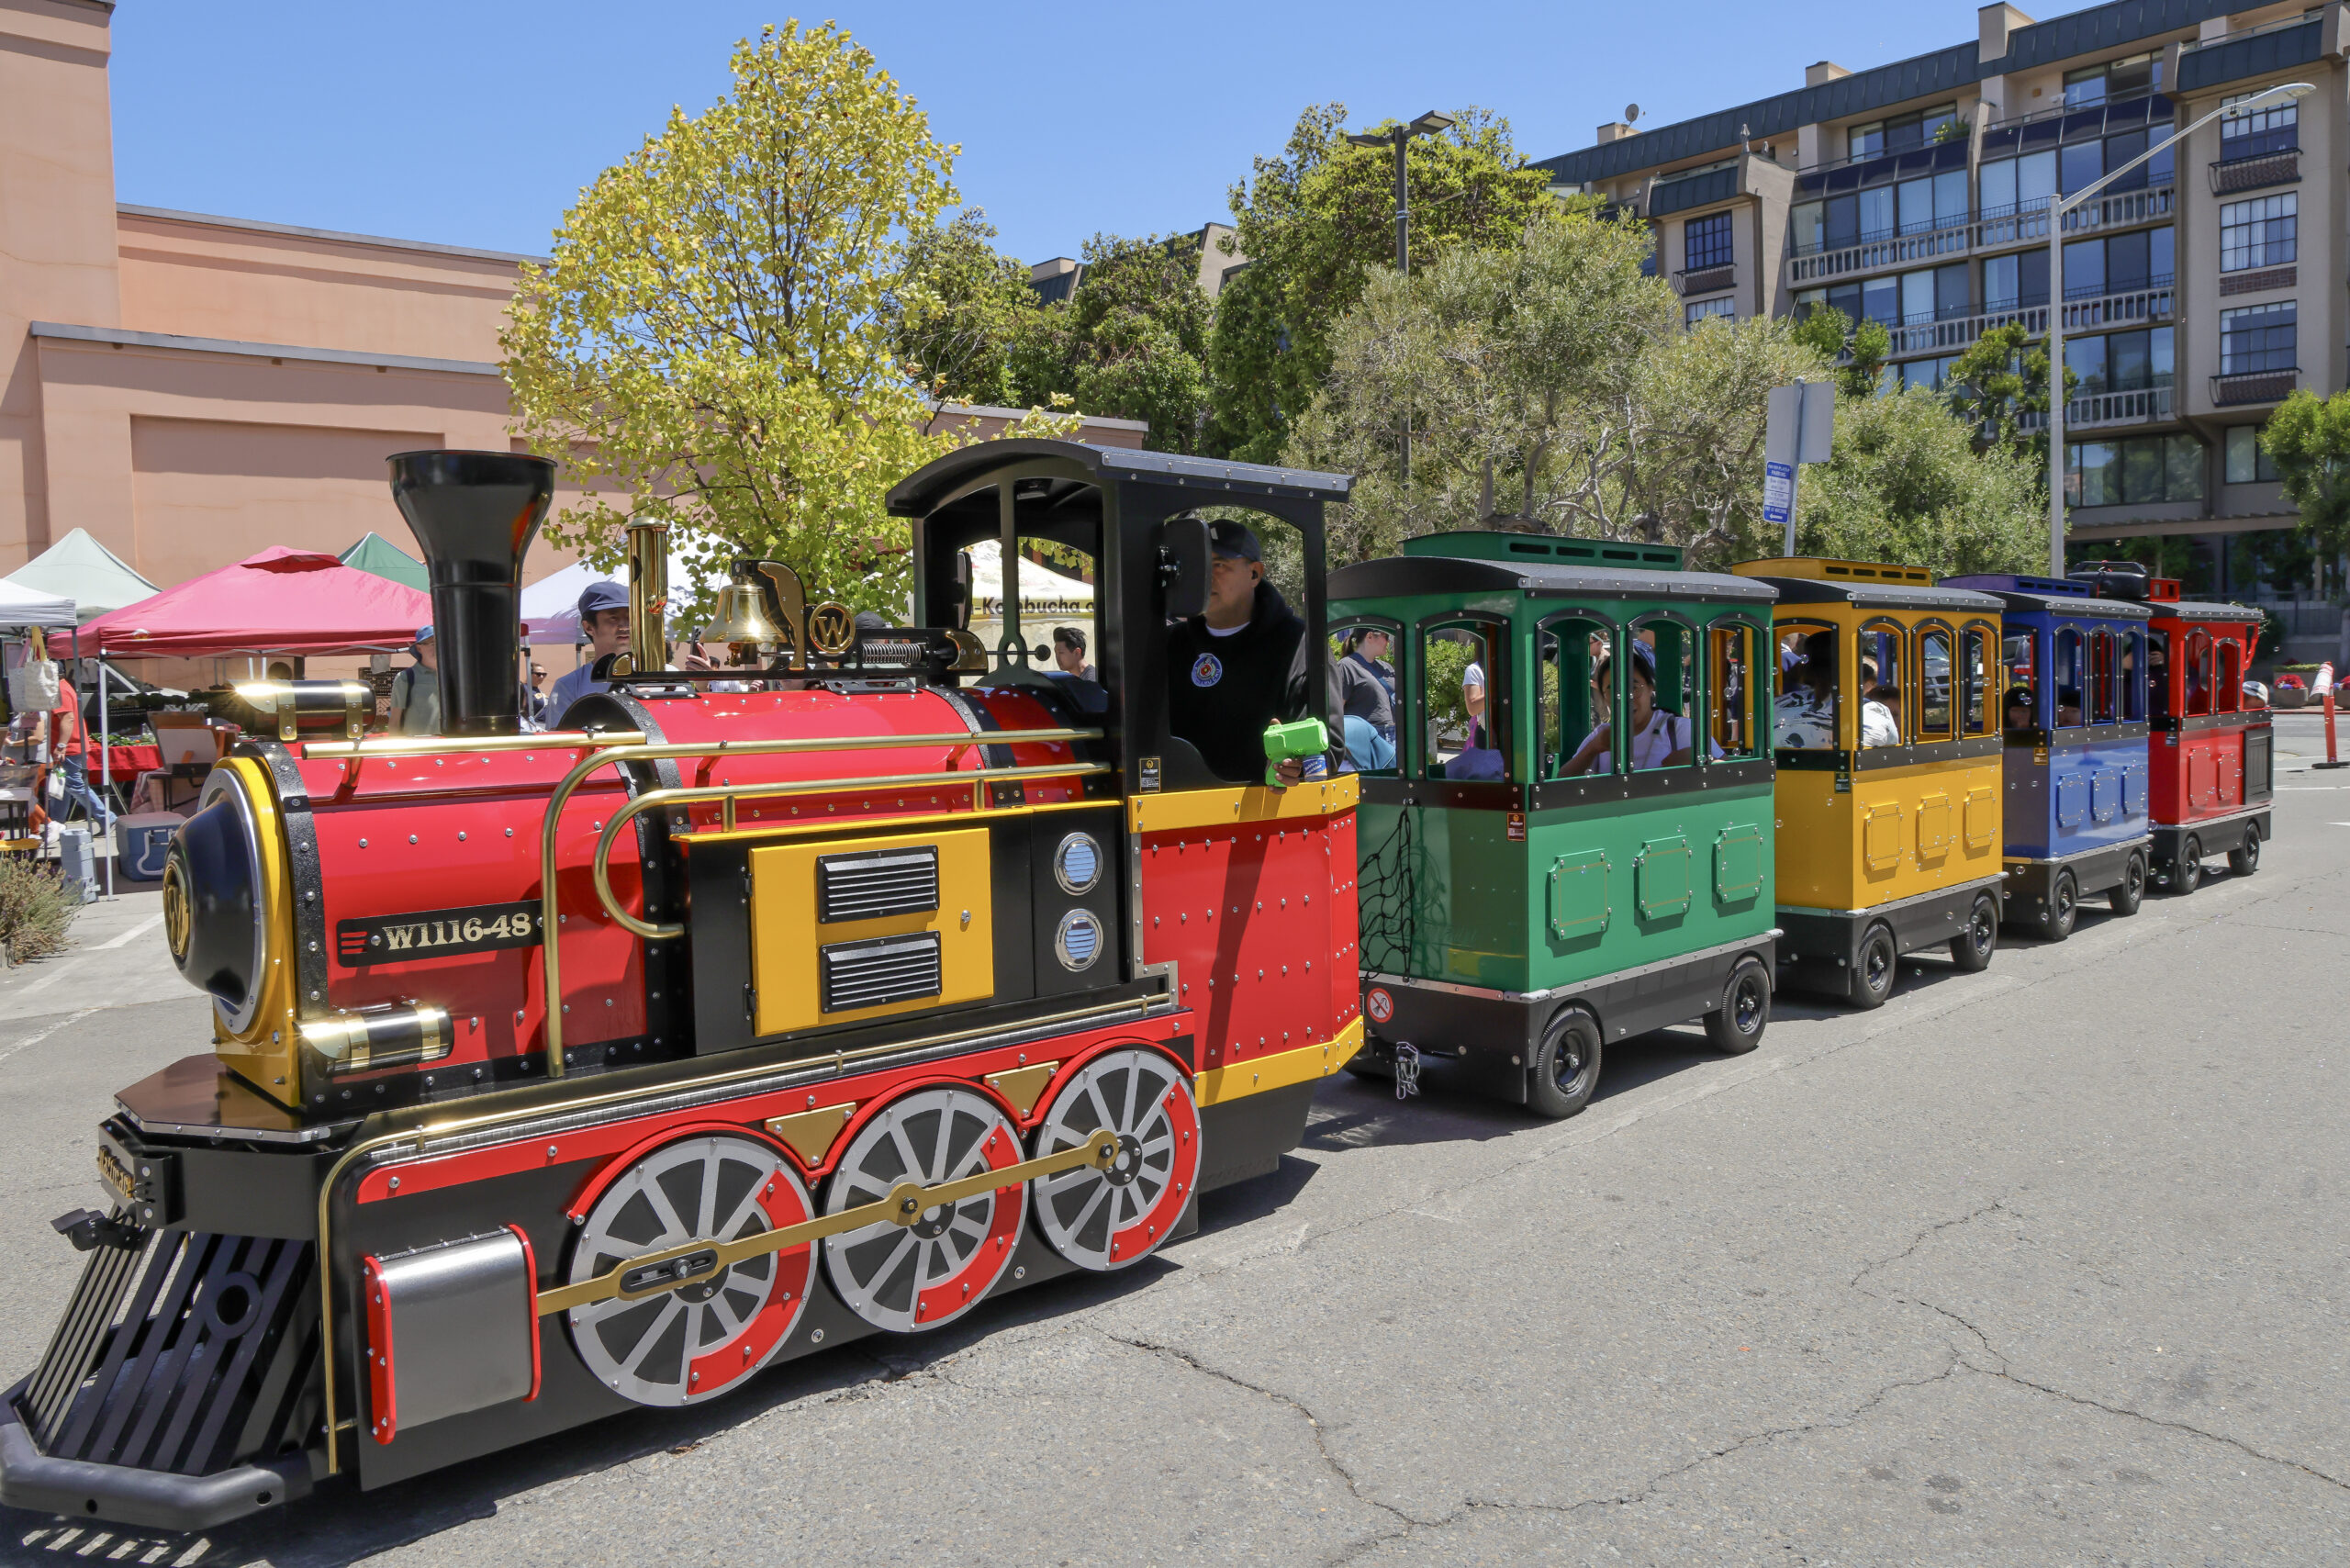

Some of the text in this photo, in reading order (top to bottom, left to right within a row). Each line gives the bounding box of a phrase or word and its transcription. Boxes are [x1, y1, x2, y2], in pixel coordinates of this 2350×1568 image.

[971, 595, 1080, 614] -Kobucha
[814, 610, 851, 649] W
[382, 913, 532, 951] W1116-48
